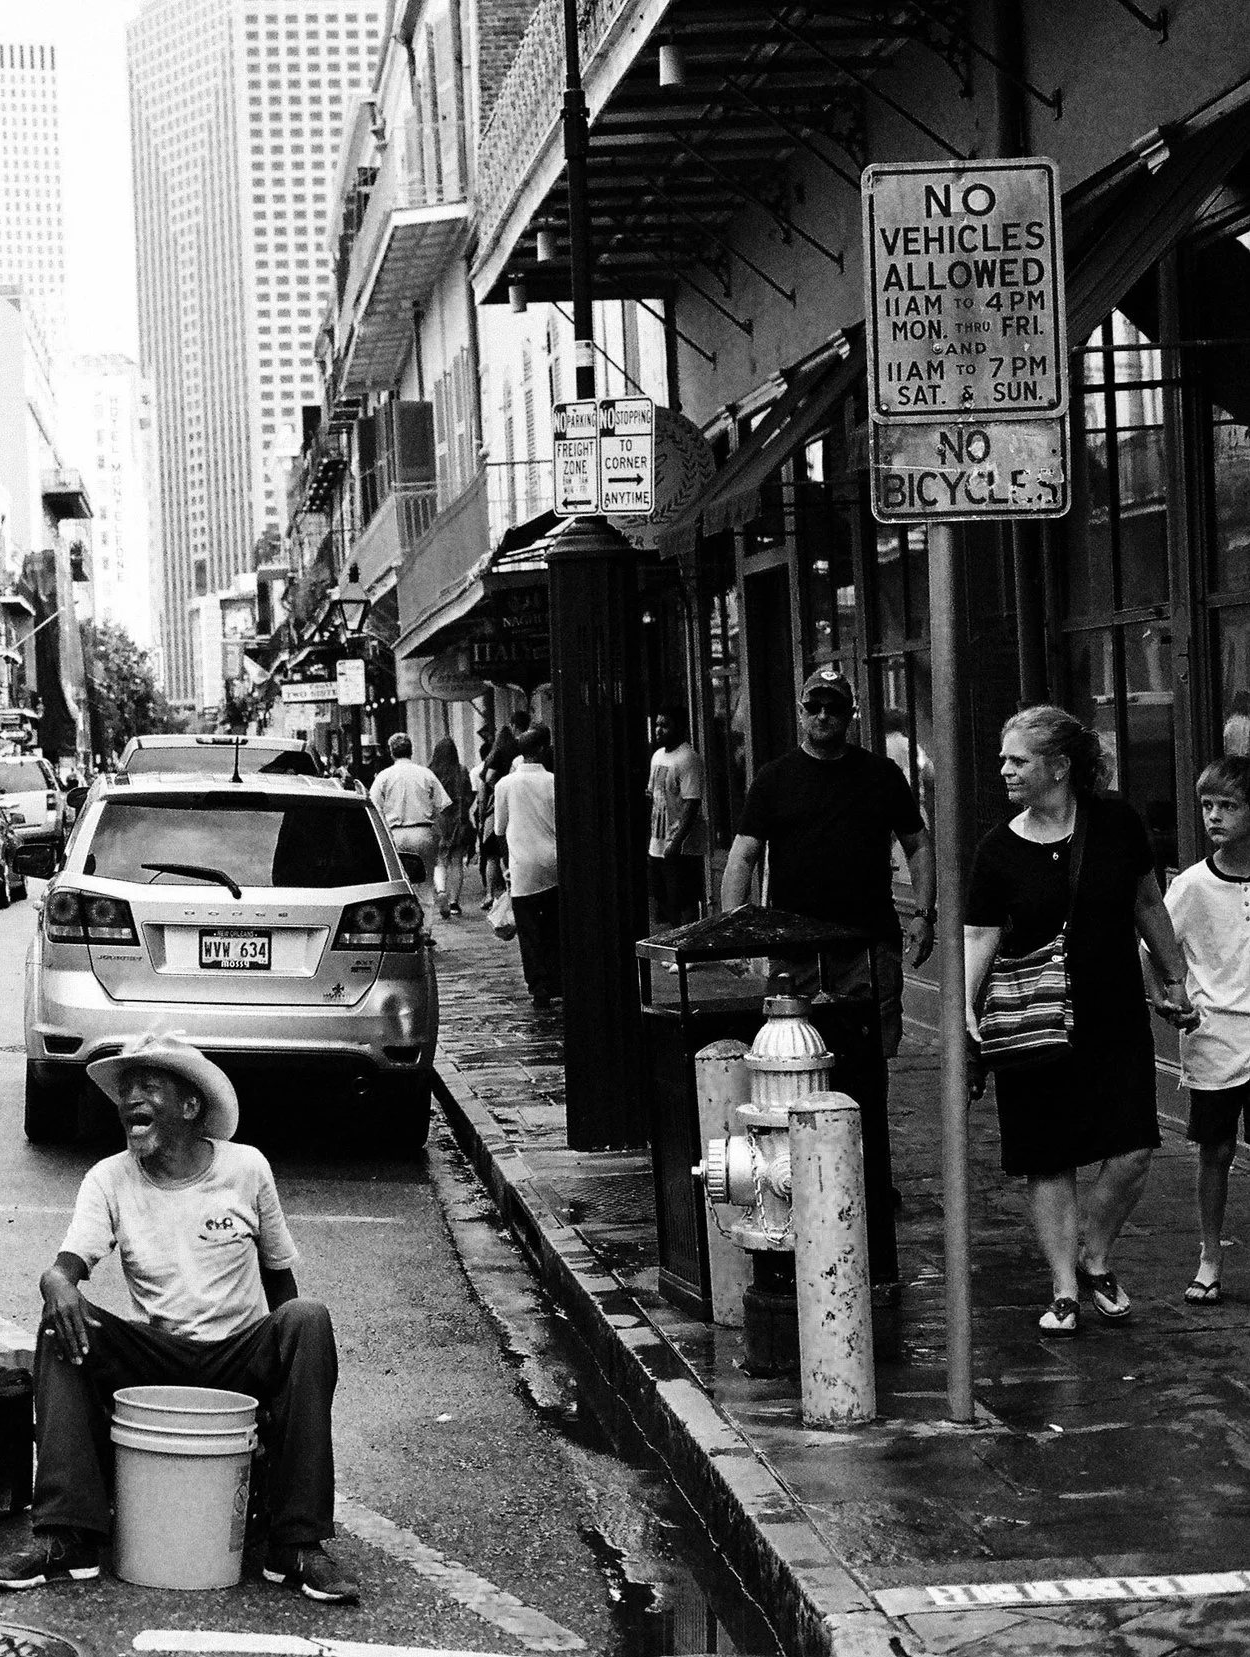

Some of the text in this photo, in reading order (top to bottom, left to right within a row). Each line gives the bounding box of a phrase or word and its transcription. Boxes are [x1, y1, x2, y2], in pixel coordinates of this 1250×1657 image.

[924, 183, 996, 218] NO
[880, 221, 1046, 256] VEHICLES
[882, 257, 1046, 292] ALLOWED
[885, 294, 943, 317] 11AM
[953, 298, 975, 310] TO
[892, 315, 1044, 341] MON. THRU FRI.
[945, 342, 987, 356] AND
[887, 360, 945, 382] 11AM
[955, 364, 976, 375] TO
[897, 381, 1043, 406] SAT. & SUN.
[109, 396, 119, 454] HOTEL
[553, 411, 597, 433] NO PARKING
[600, 407, 651, 430] NO STOPPING
[557, 441, 594, 458] FREIGHT
[620, 439, 632, 452] TO
[939, 427, 991, 465] NO
[563, 460, 587, 475] ZONE
[605, 455, 648, 470] CORNER
[604, 491, 650, 506] ANYTIME
[882, 469, 1058, 509] BICYCLES
[230, 930, 255, 938] ORLEANS
[204, 941, 266, 959] WVW 634
